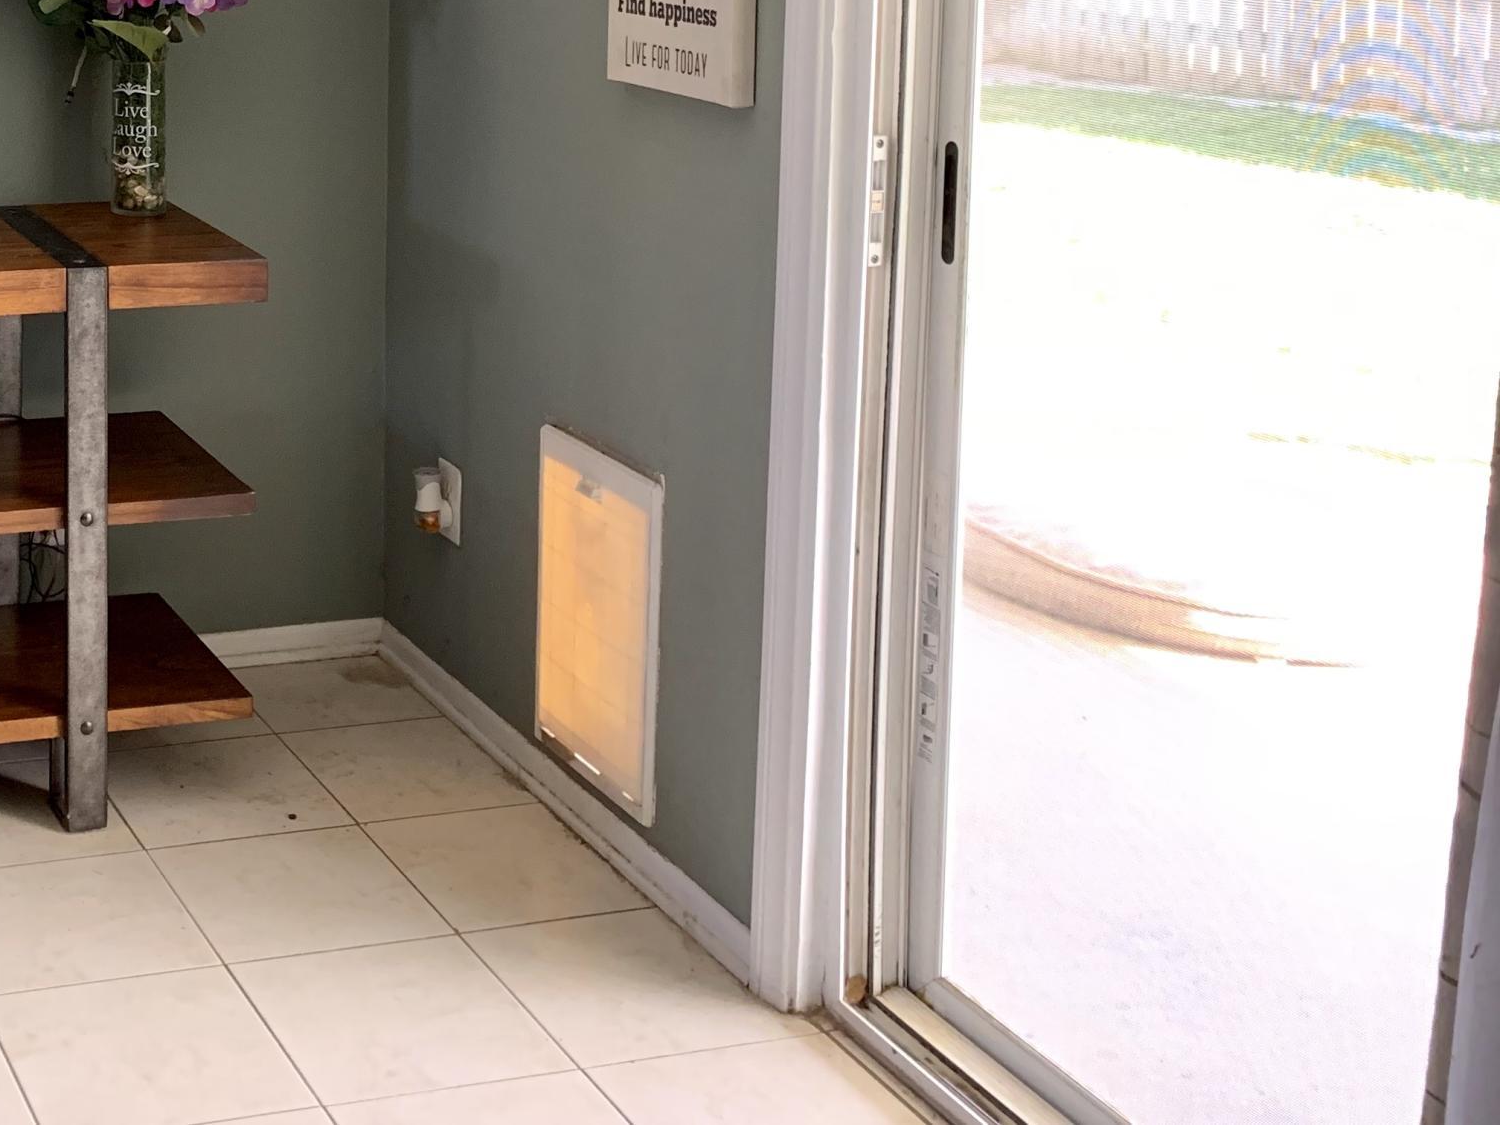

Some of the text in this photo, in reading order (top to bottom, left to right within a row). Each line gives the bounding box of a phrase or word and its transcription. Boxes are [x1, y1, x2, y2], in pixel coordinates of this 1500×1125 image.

[624, 36, 708, 78] LIVE FOR TODAY
[114, 98, 149, 119] Live
[114, 124, 158, 143] augh
[113, 136, 152, 158] Love
